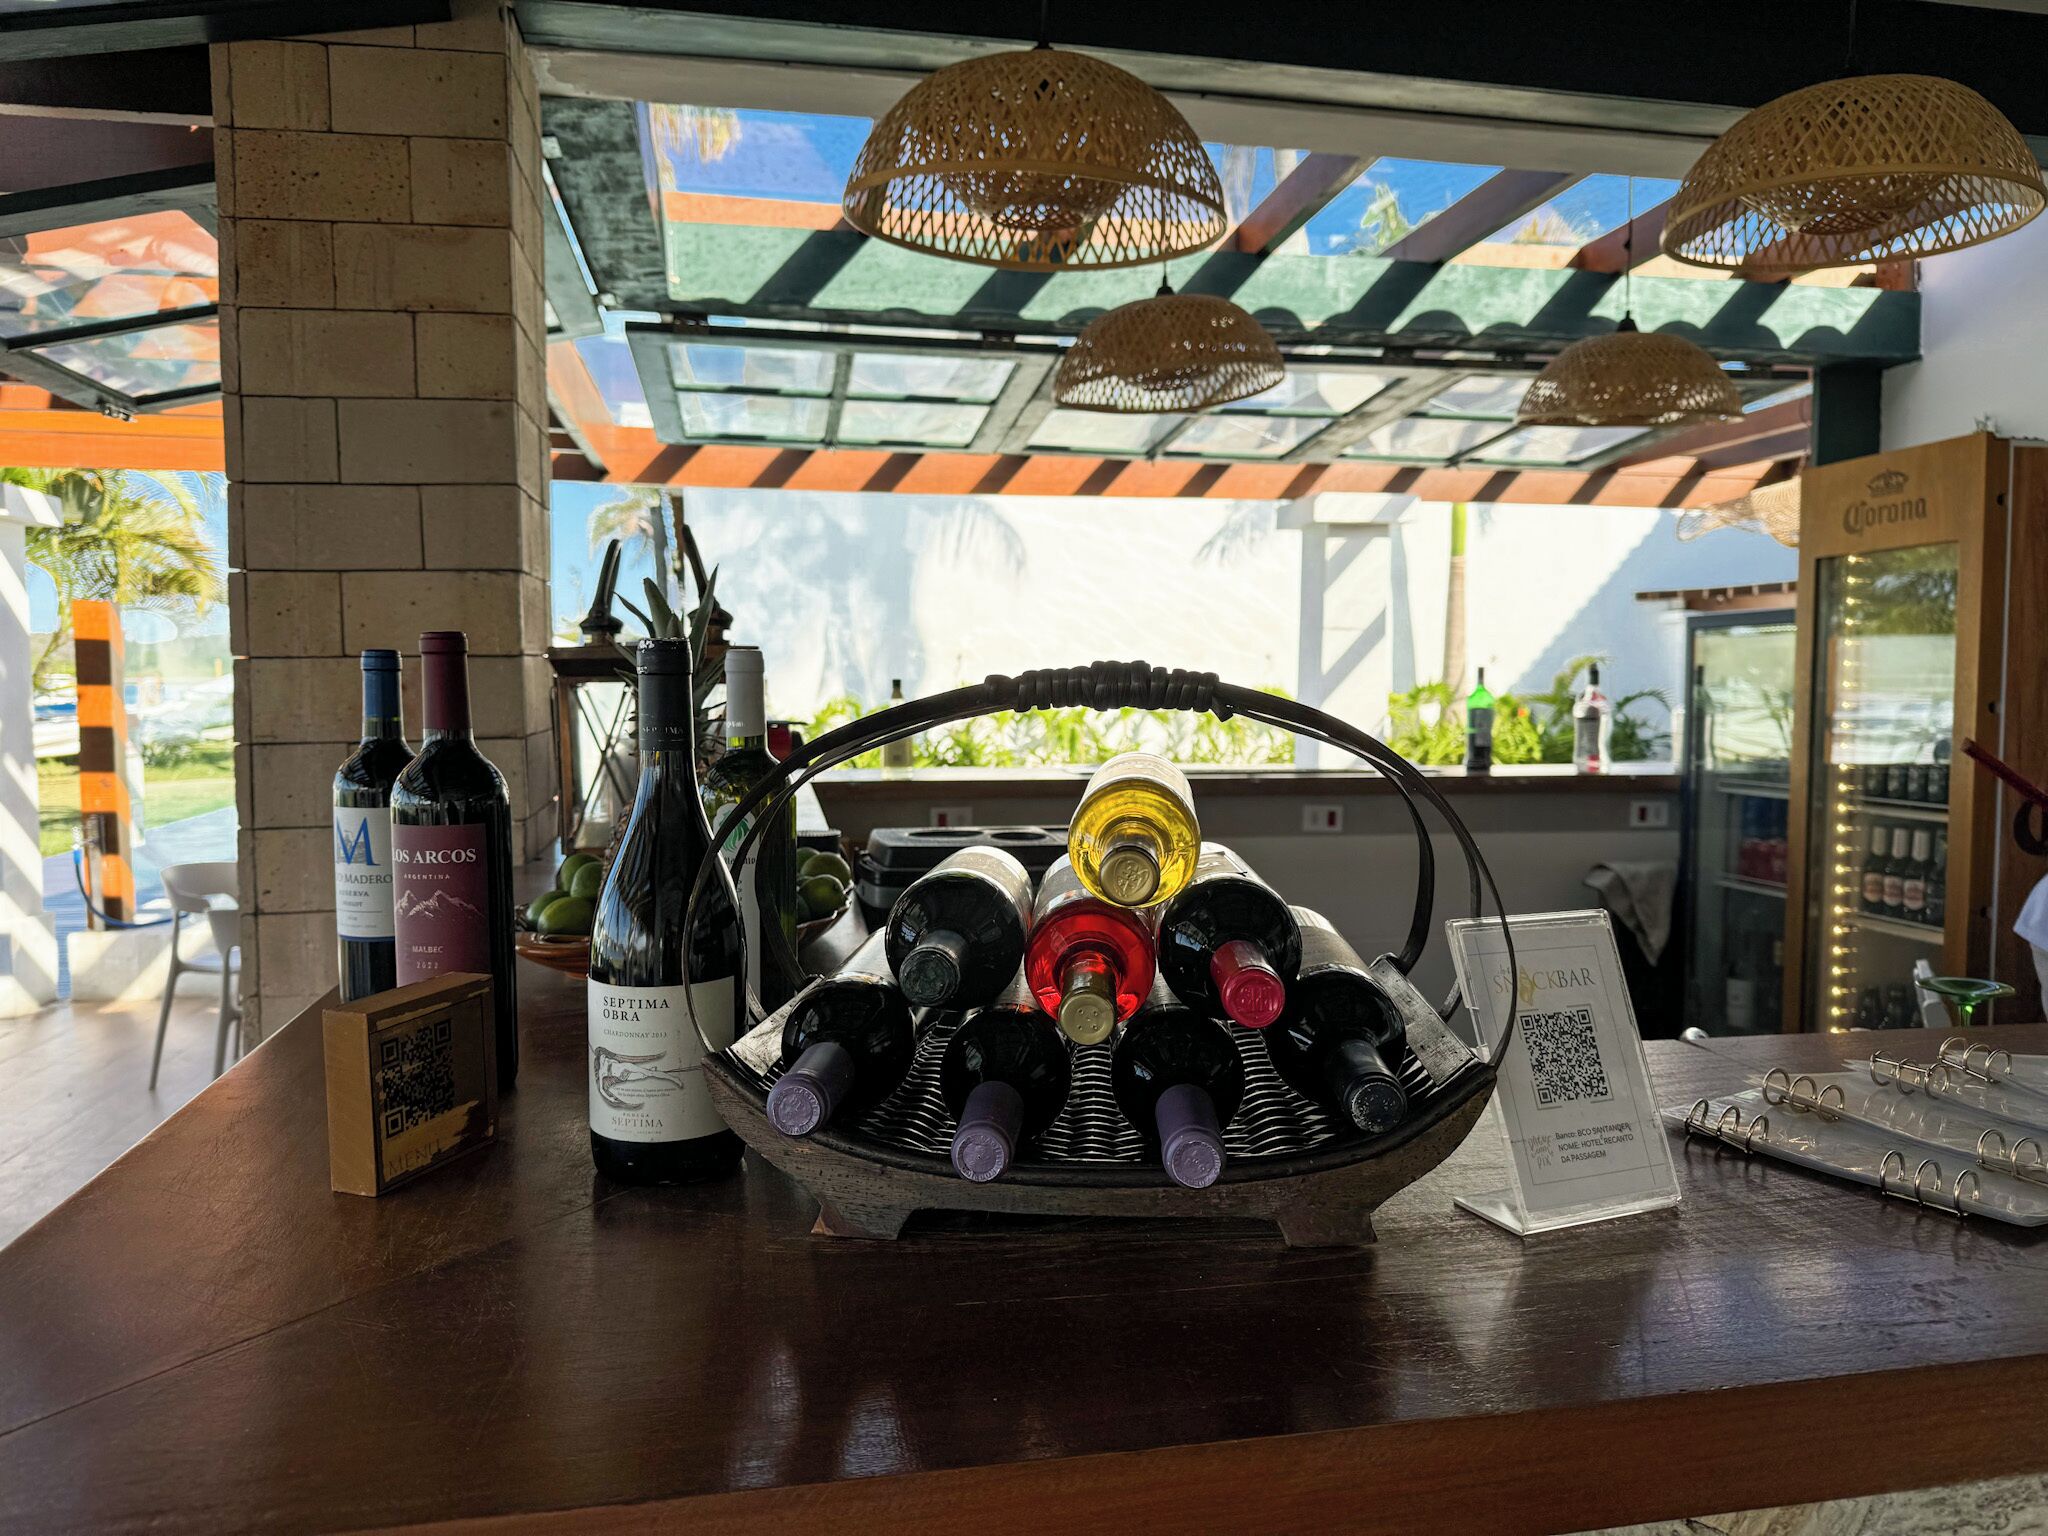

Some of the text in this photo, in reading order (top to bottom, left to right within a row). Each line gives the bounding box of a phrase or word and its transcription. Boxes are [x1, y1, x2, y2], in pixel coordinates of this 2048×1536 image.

[1843, 498, 1927, 536] Corona
[642, 726, 684, 735] SEPIMA
[413, 848, 477, 864] ARCOS
[344, 873, 393, 885] MADERO
[412, 945, 444, 954] MALBEC
[1493, 967, 1596, 993] SNCKBAR
[603, 995, 670, 1009] SEPTIMA
[603, 1009, 641, 1022] OBRA
[603, 1029, 650, 1039] CHARDONNAY
[612, 1116, 663, 1128] SEPTIMA
[1555, 1131, 1576, 1140] Banco:
[1577, 1129, 1592, 1137] BCO
[1558, 1134, 1634, 1151] NOME: HOTEL RECANTO
[1561, 1150, 1607, 1163] DA PASSAGEM
